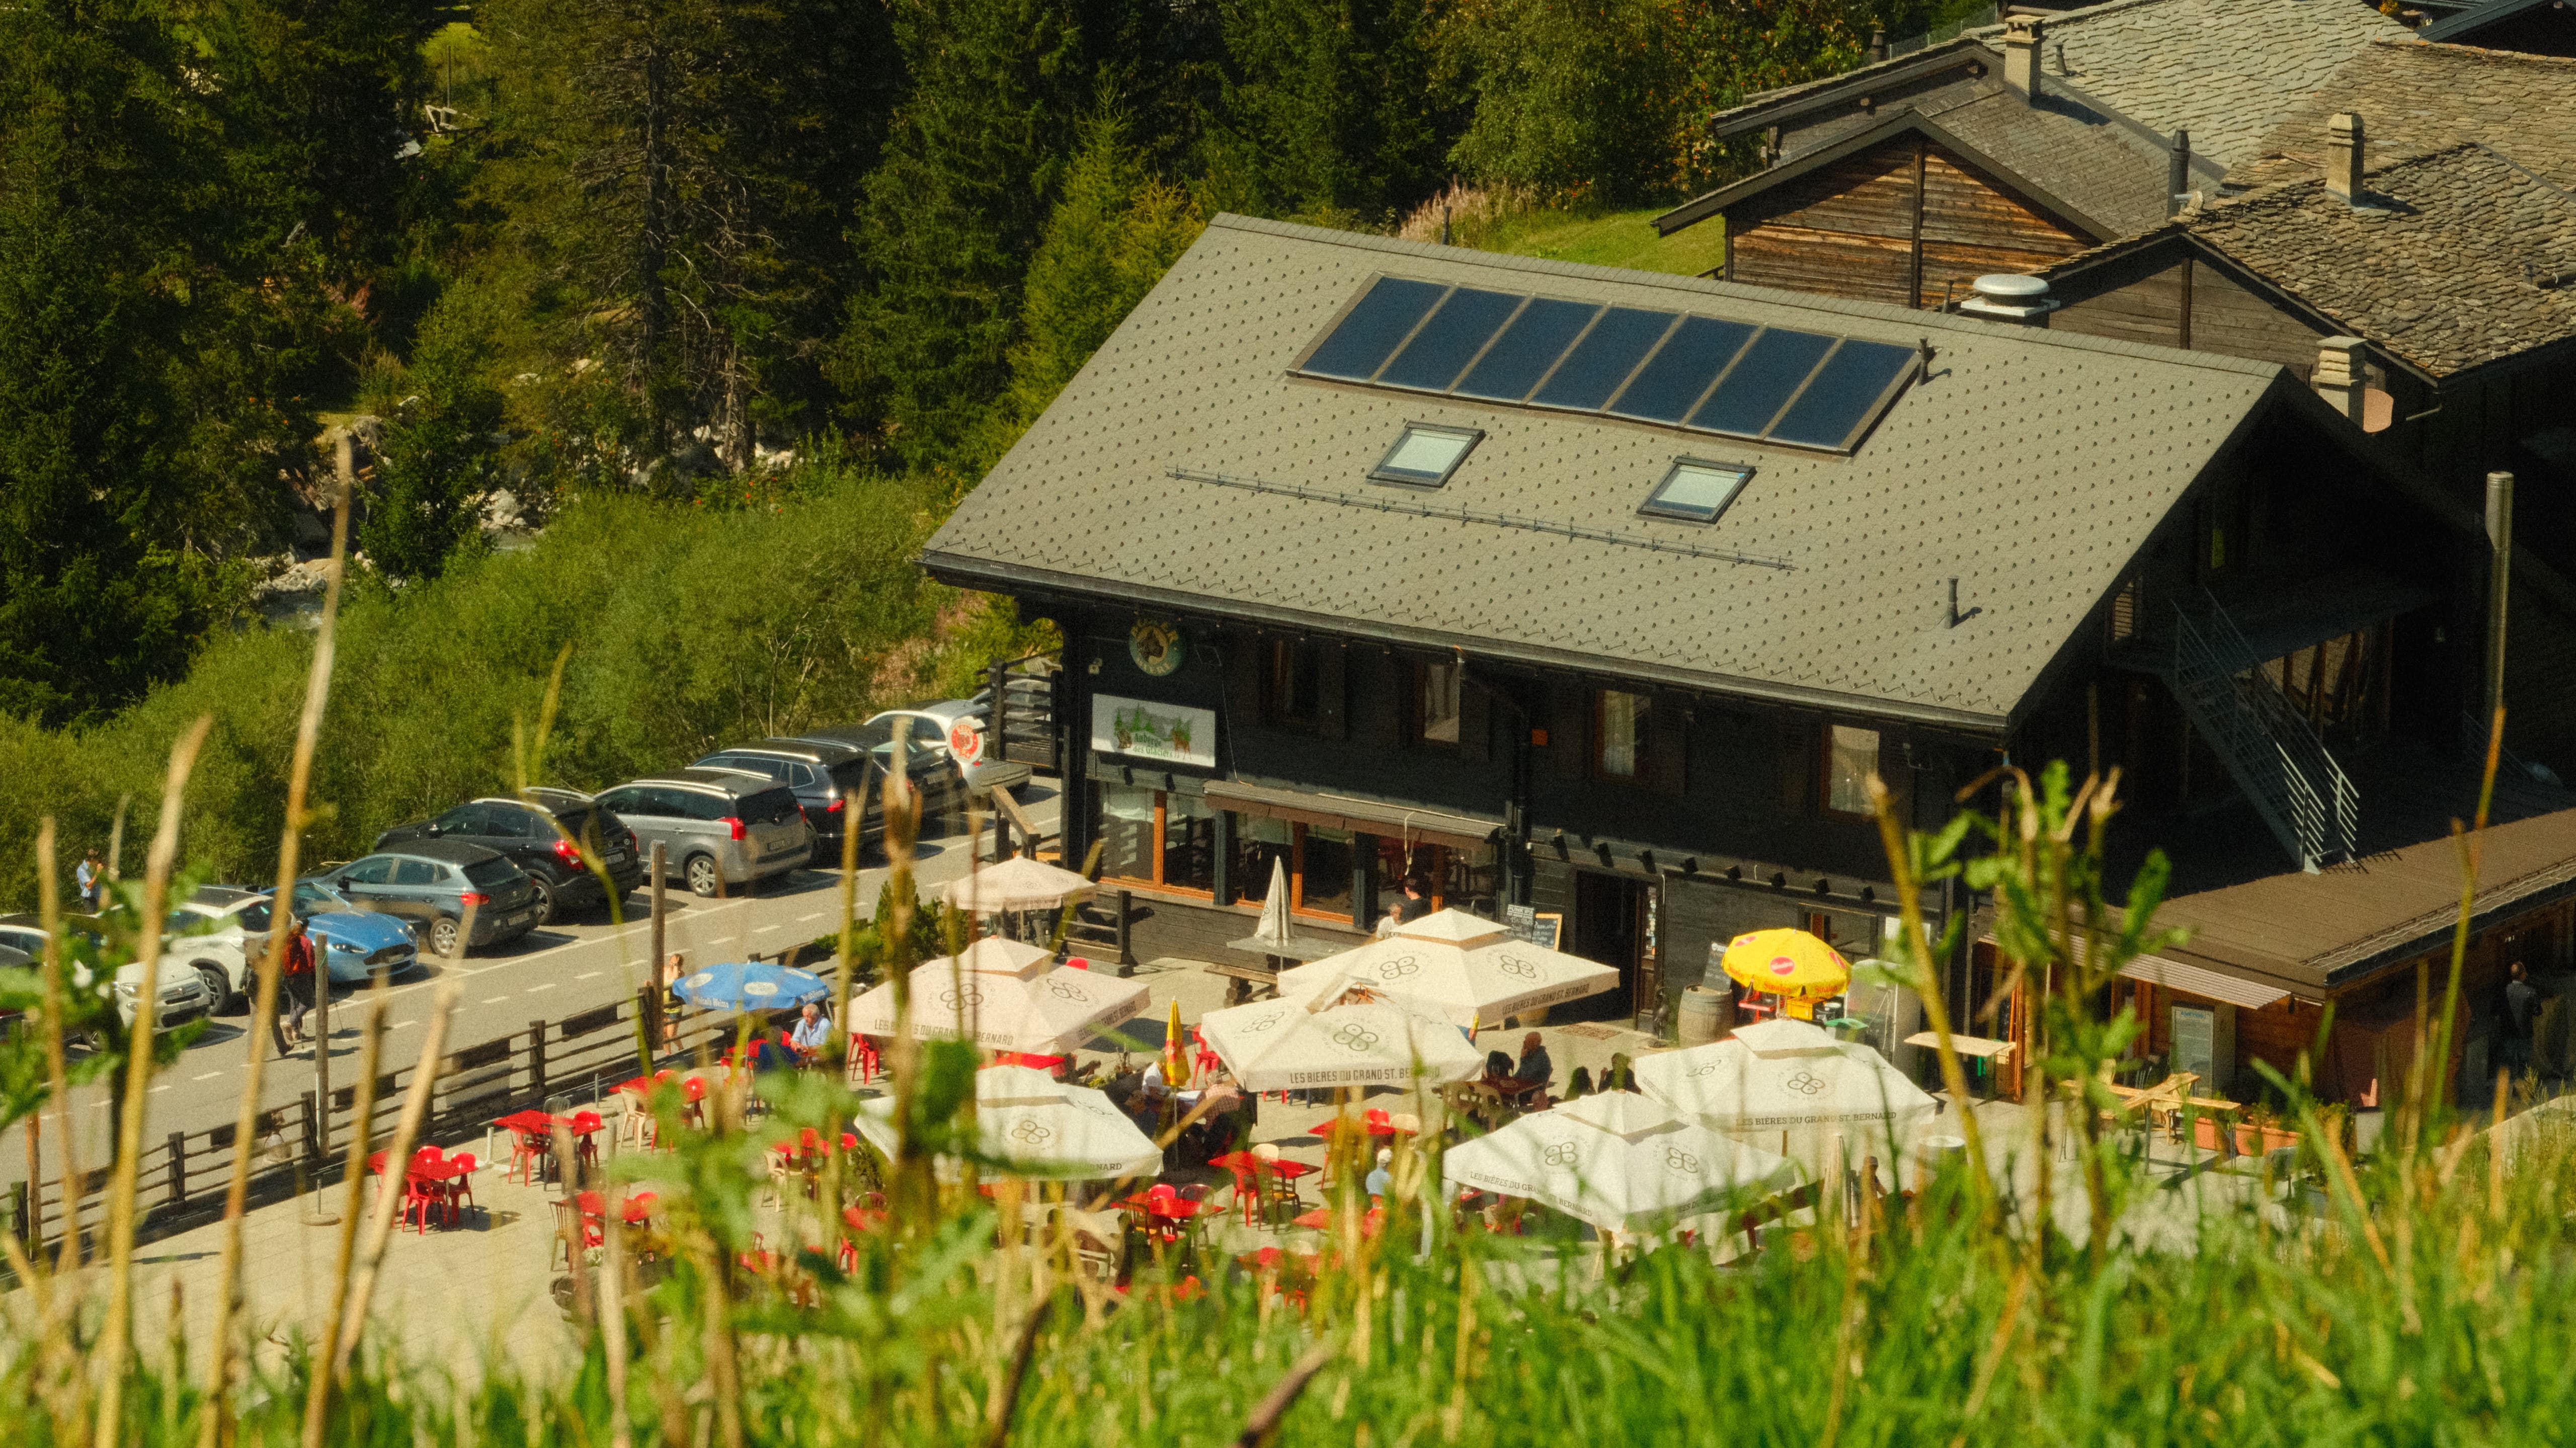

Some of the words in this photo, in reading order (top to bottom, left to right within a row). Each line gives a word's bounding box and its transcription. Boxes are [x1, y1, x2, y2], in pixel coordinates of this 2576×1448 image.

[1135, 733, 1162, 747] Auberge
[1146, 747, 1173, 758] Glaciers
[1502, 1003, 1512, 1014] LES
[1530, 996, 1538, 1006] DU
[1538, 992, 1556, 1004] GRAND
[1565, 983, 1590, 997] BERNARD
[874, 1019, 889, 1031] LES
[920, 1024, 931, 1036] DU
[1290, 1073, 1305, 1083] LES
[1308, 1071, 1337, 1082] BIERES
[1340, 1070, 1351, 1081] DU
[1353, 1069, 1382, 1080] GRAND
[1385, 1068, 1397, 1079] ST.
[1755, 1115, 1787, 1125] BIÈRES
[1470, 1171, 1481, 1181] LES
[1484, 1175, 1507, 1187] BIÈRES
[1509, 1180, 1520, 1189] DU
